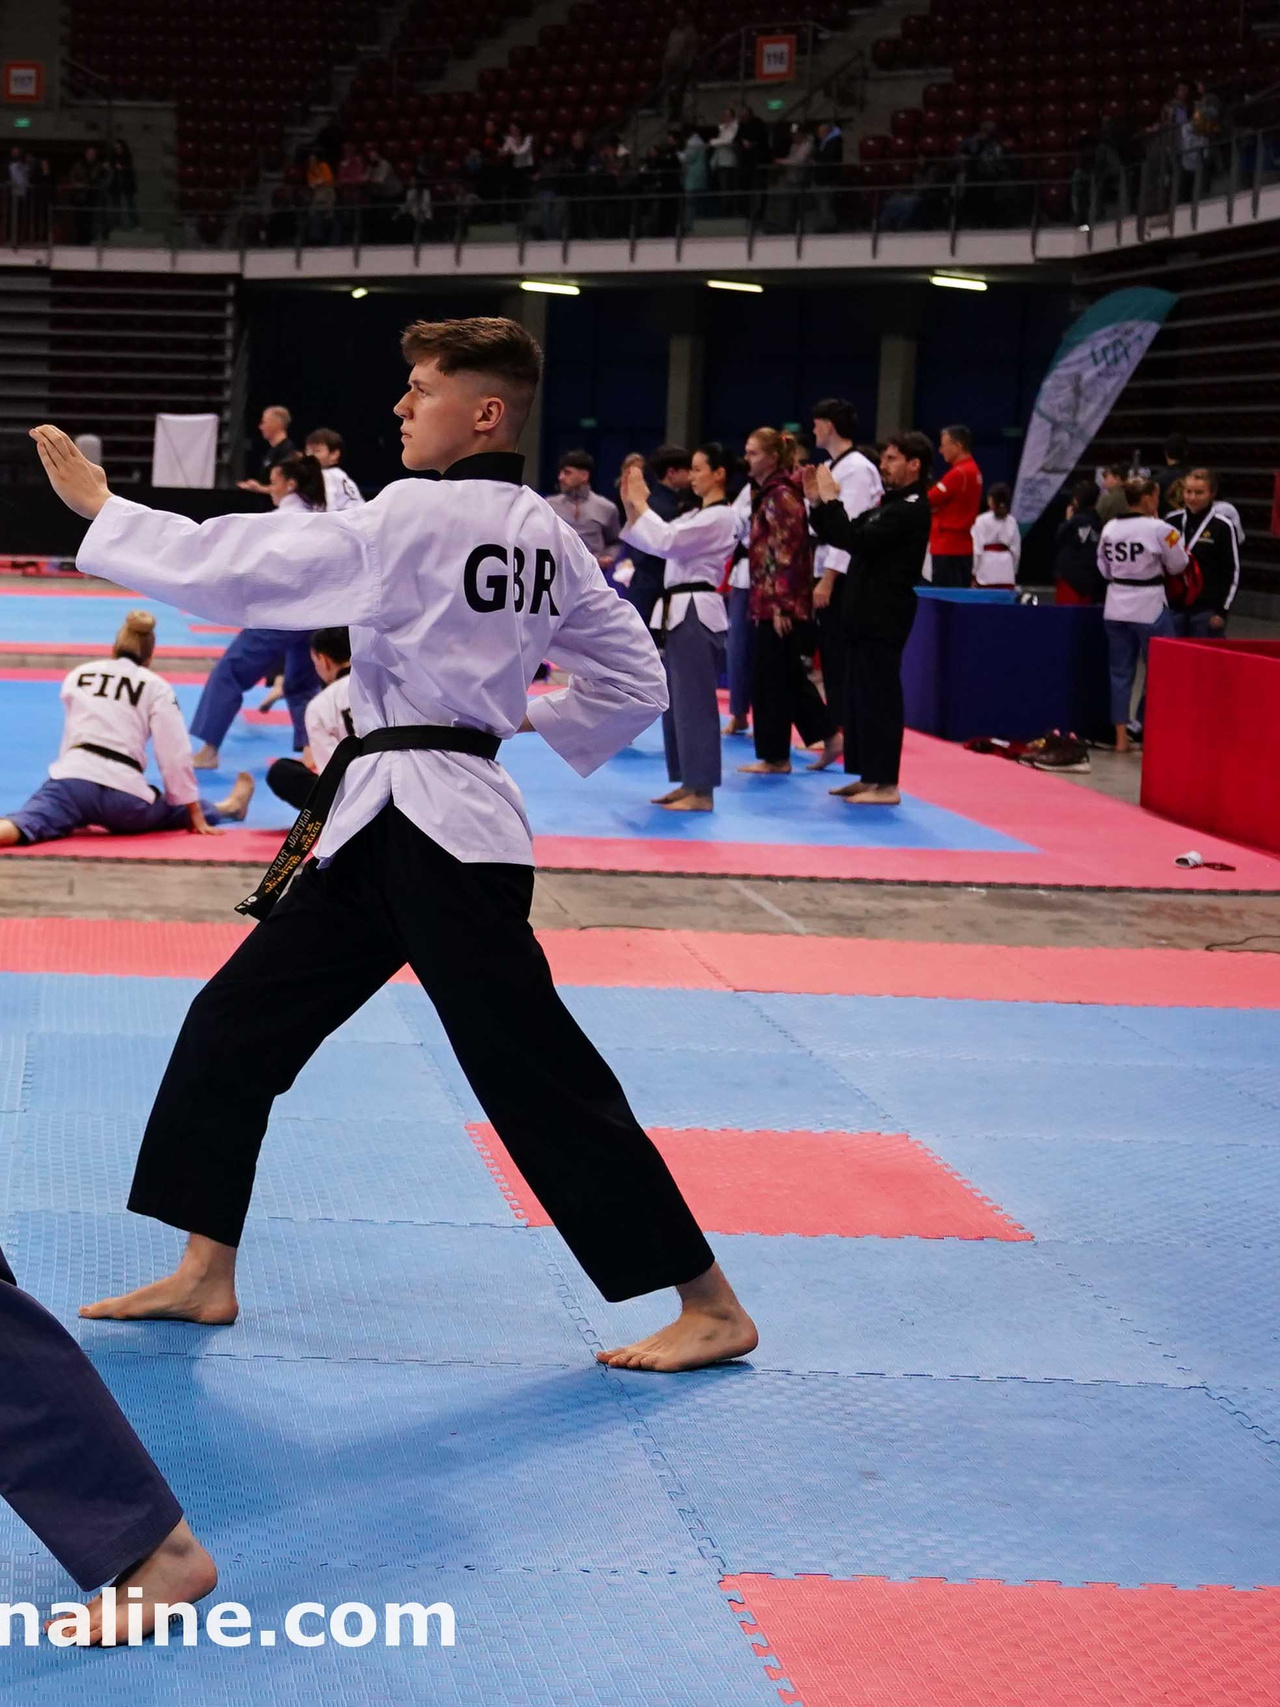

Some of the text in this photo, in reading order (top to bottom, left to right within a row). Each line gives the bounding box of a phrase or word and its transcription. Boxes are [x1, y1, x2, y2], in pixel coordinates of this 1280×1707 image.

[1102, 542, 1145, 562] ESP
[463, 543, 560, 616] GBR
[77, 672, 146, 708] FIN
